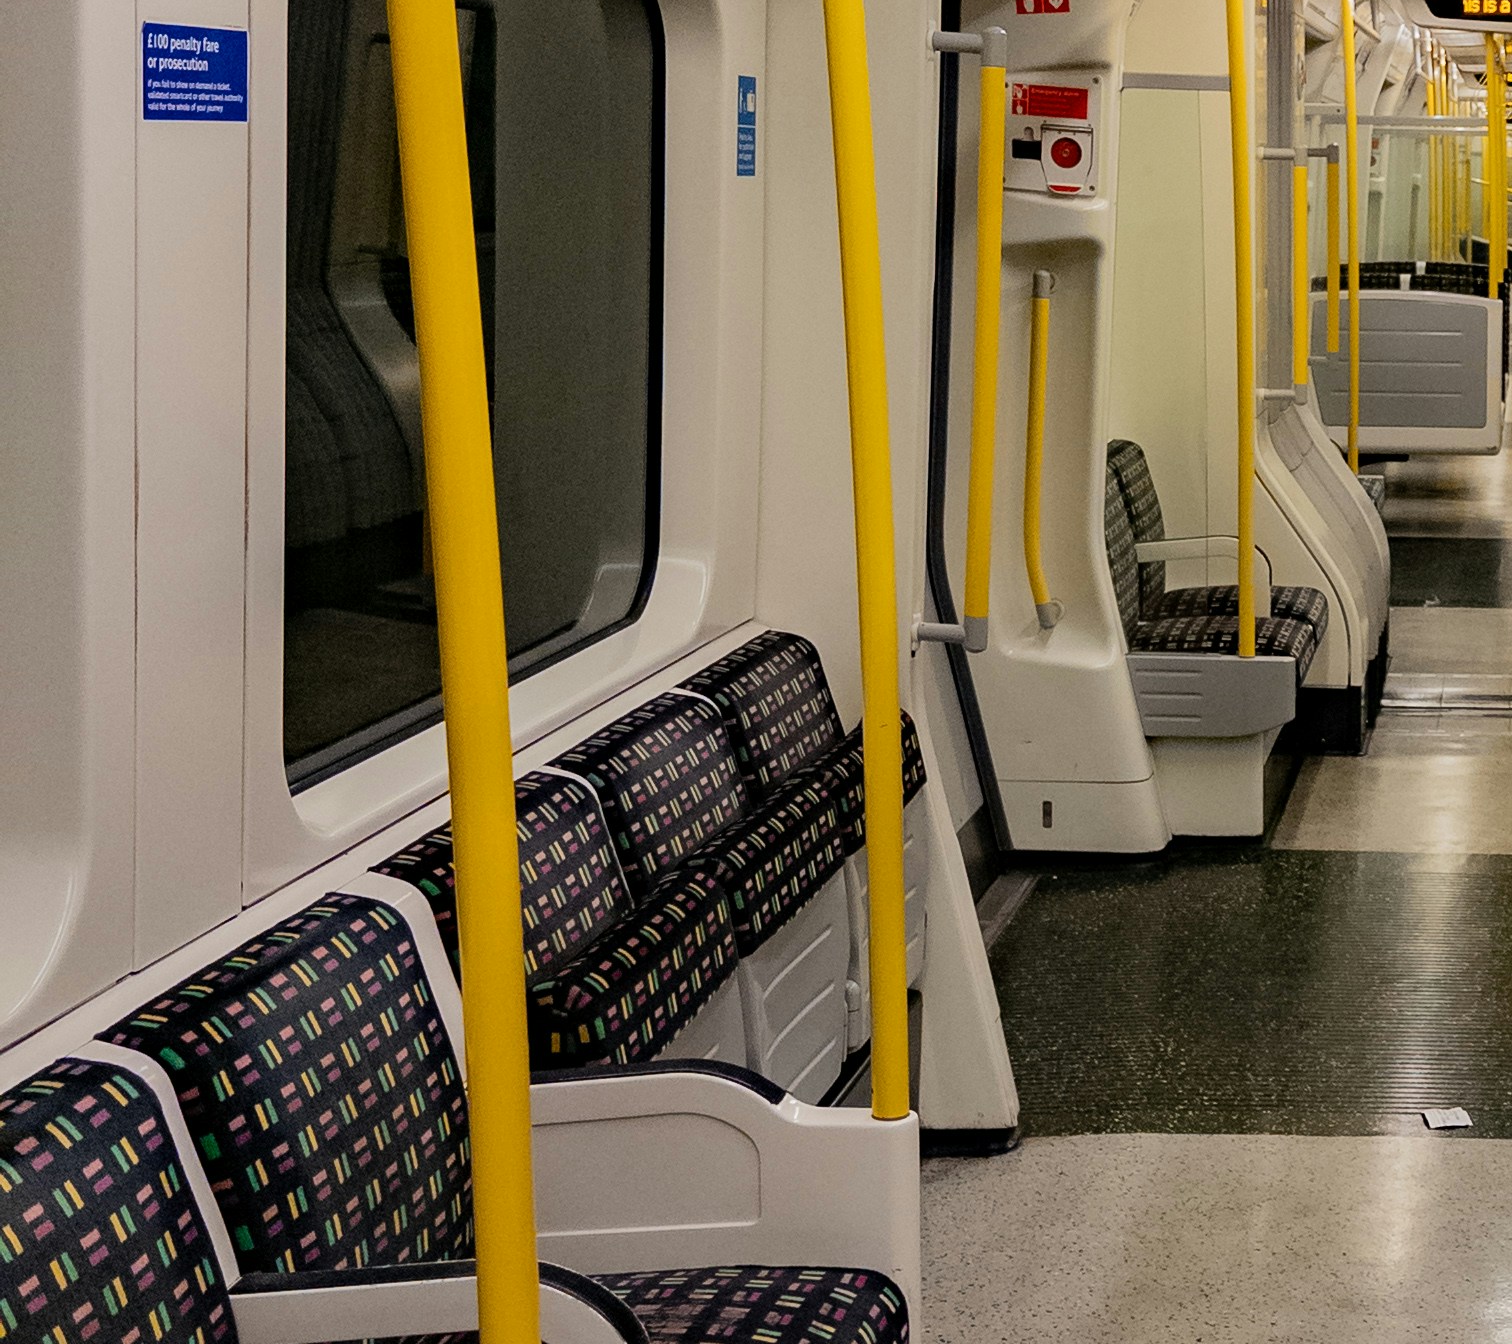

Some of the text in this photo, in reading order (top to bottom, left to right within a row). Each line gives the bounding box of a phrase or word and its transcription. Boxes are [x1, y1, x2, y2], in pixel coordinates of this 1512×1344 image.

[1500, 0, 1511, 14] a
[147, 33, 220, 55] £100 penalty fare
[147, 56, 208, 72] or prosecution
